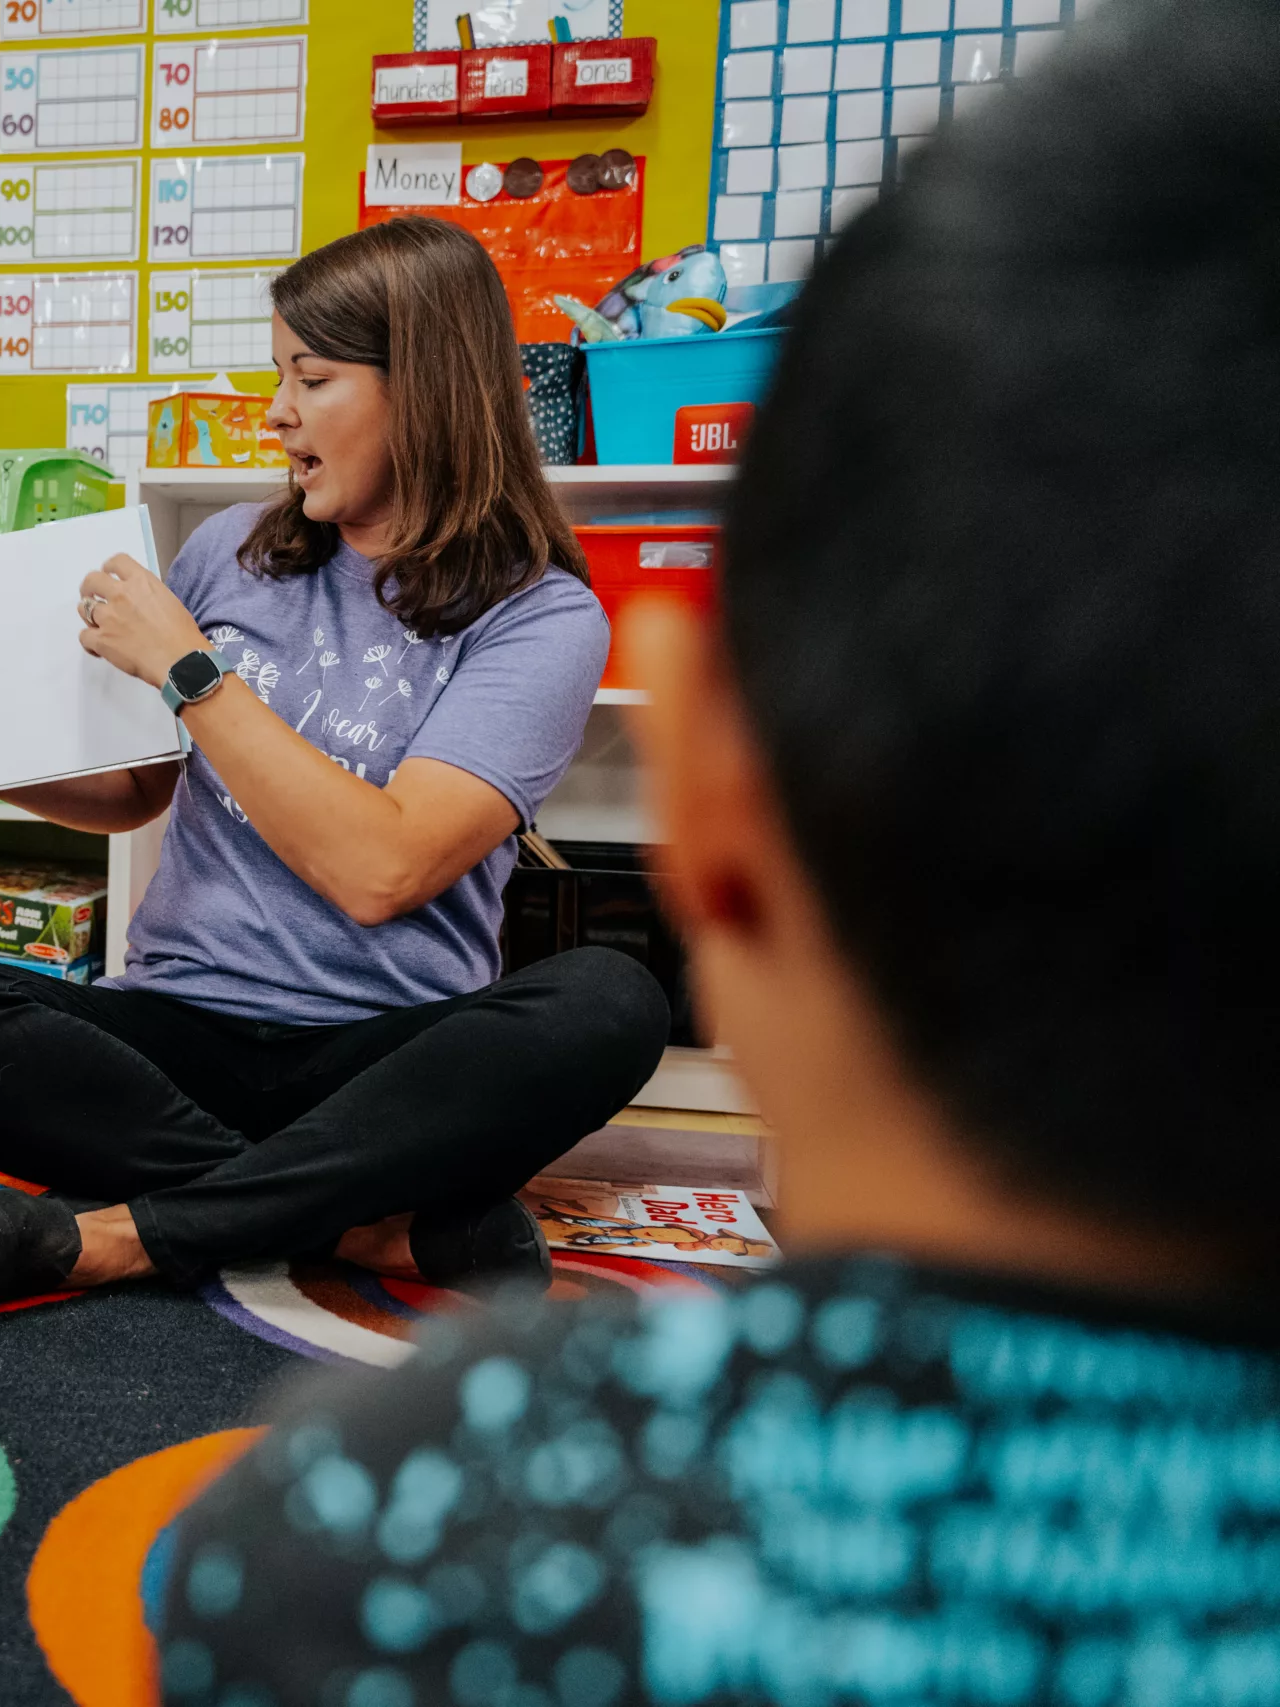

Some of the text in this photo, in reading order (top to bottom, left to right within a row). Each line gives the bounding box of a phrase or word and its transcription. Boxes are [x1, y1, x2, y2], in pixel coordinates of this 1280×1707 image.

[5, 0, 37, 23] 20
[162, 0, 192, 18] 40
[3, 68, 35, 90] 50
[159, 63, 190, 86] 70
[487, 70, 524, 96] tens
[580, 61, 627, 83] ones
[378, 74, 454, 100] hundreds
[2, 114, 33, 136] 60
[158, 107, 190, 131] 80
[0, 179, 31, 202] 90
[158, 179, 188, 203] 110
[375, 158, 456, 201] Money
[154, 225, 189, 247] 120
[155, 291, 189, 312] 150
[154, 337, 189, 357] 160
[71, 403, 108, 425] 170
[691, 422, 737, 453] JBL
[641, 1199, 698, 1225] Dad
[692, 1192, 740, 1225] Hero
